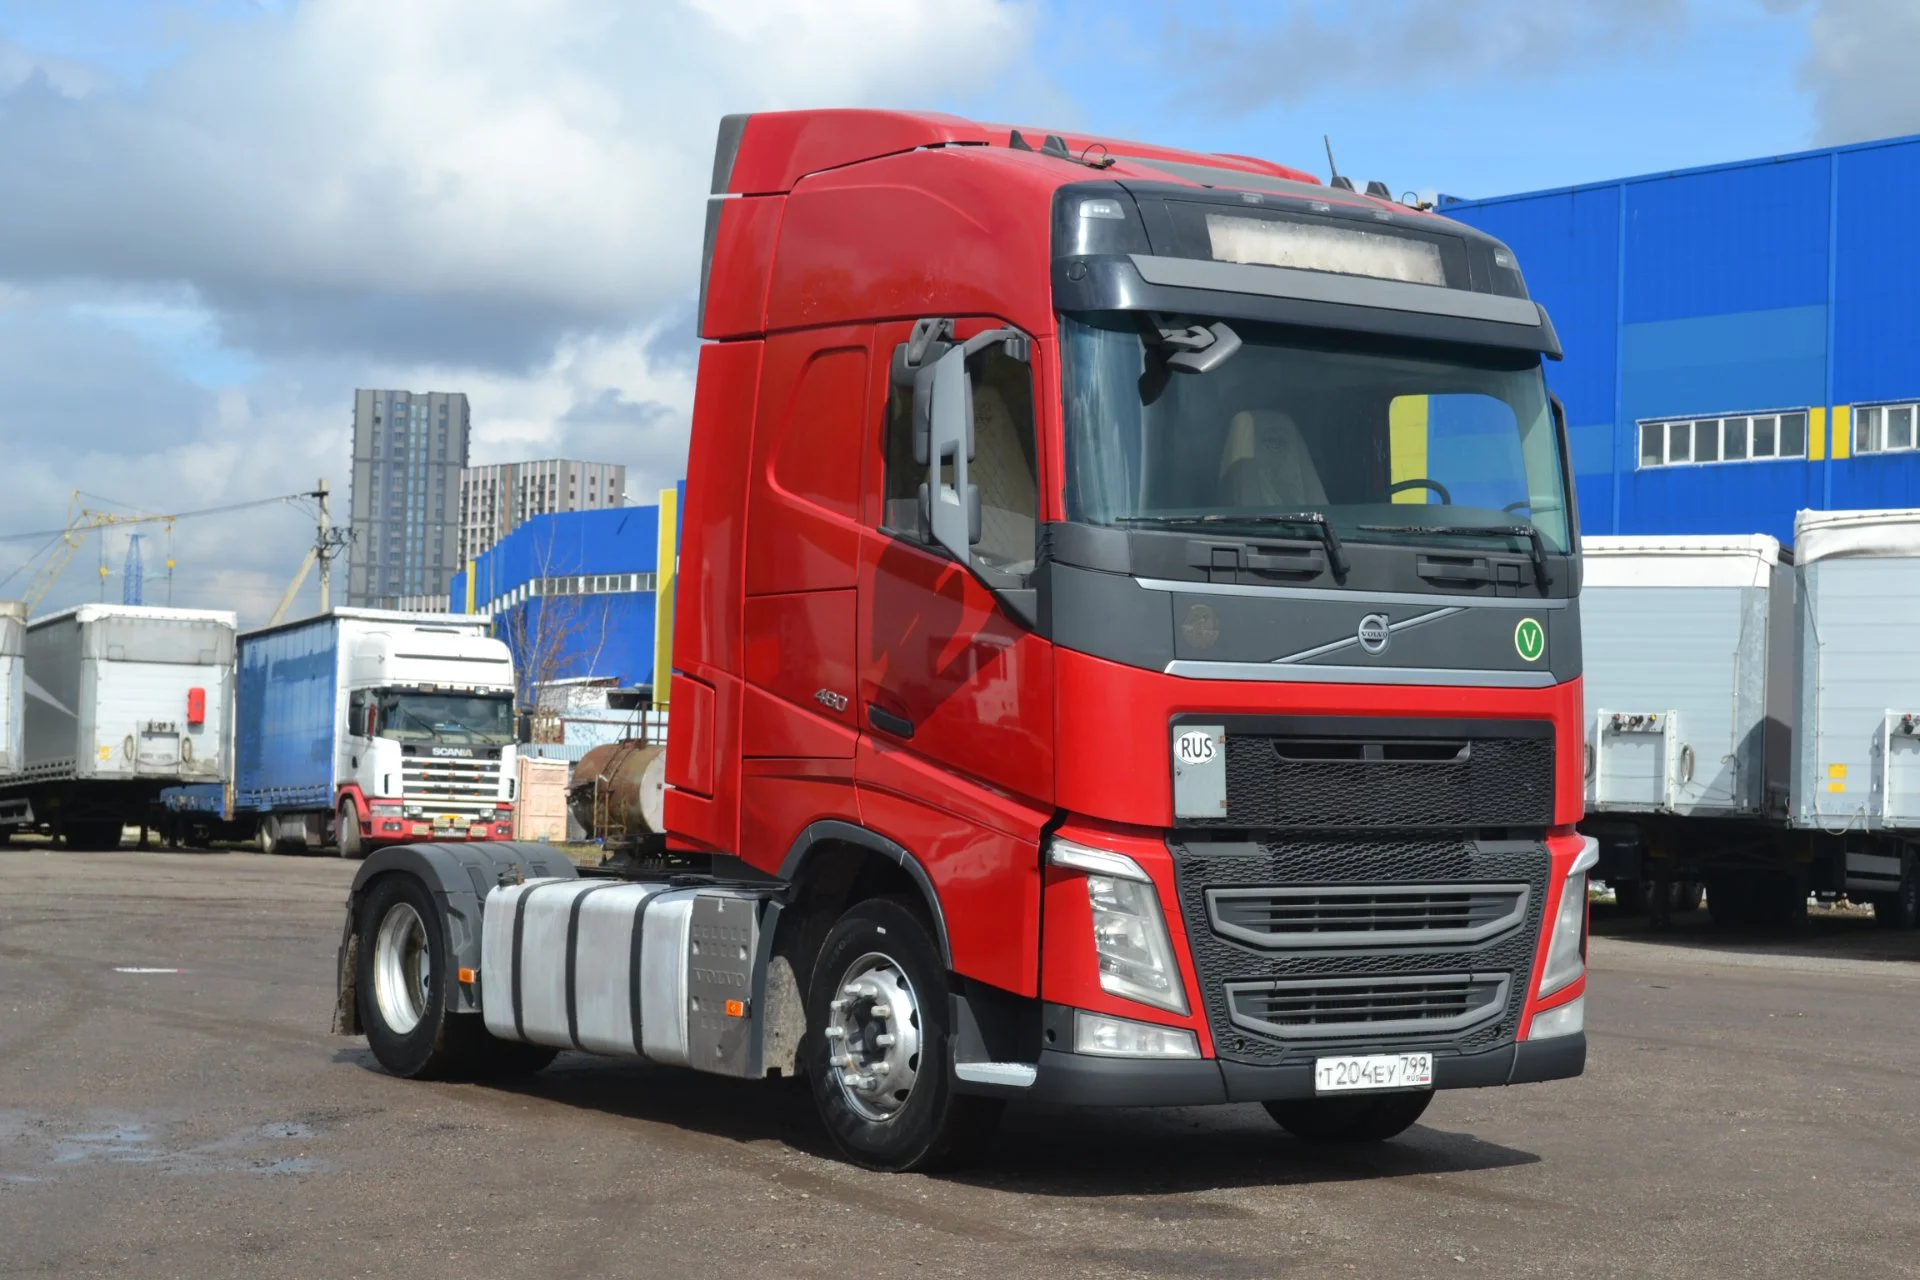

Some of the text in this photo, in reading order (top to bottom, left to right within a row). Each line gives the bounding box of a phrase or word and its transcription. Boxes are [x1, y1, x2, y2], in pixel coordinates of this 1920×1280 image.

[1522, 628, 1537, 652] V
[815, 688, 848, 712] 460
[432, 747, 474, 758] SCANIA
[1181, 737, 1213, 758] RUS
[692, 967, 746, 987] VOLVO
[1400, 1056, 1428, 1076] 799
[1406, 1074, 1420, 1082] RUS
